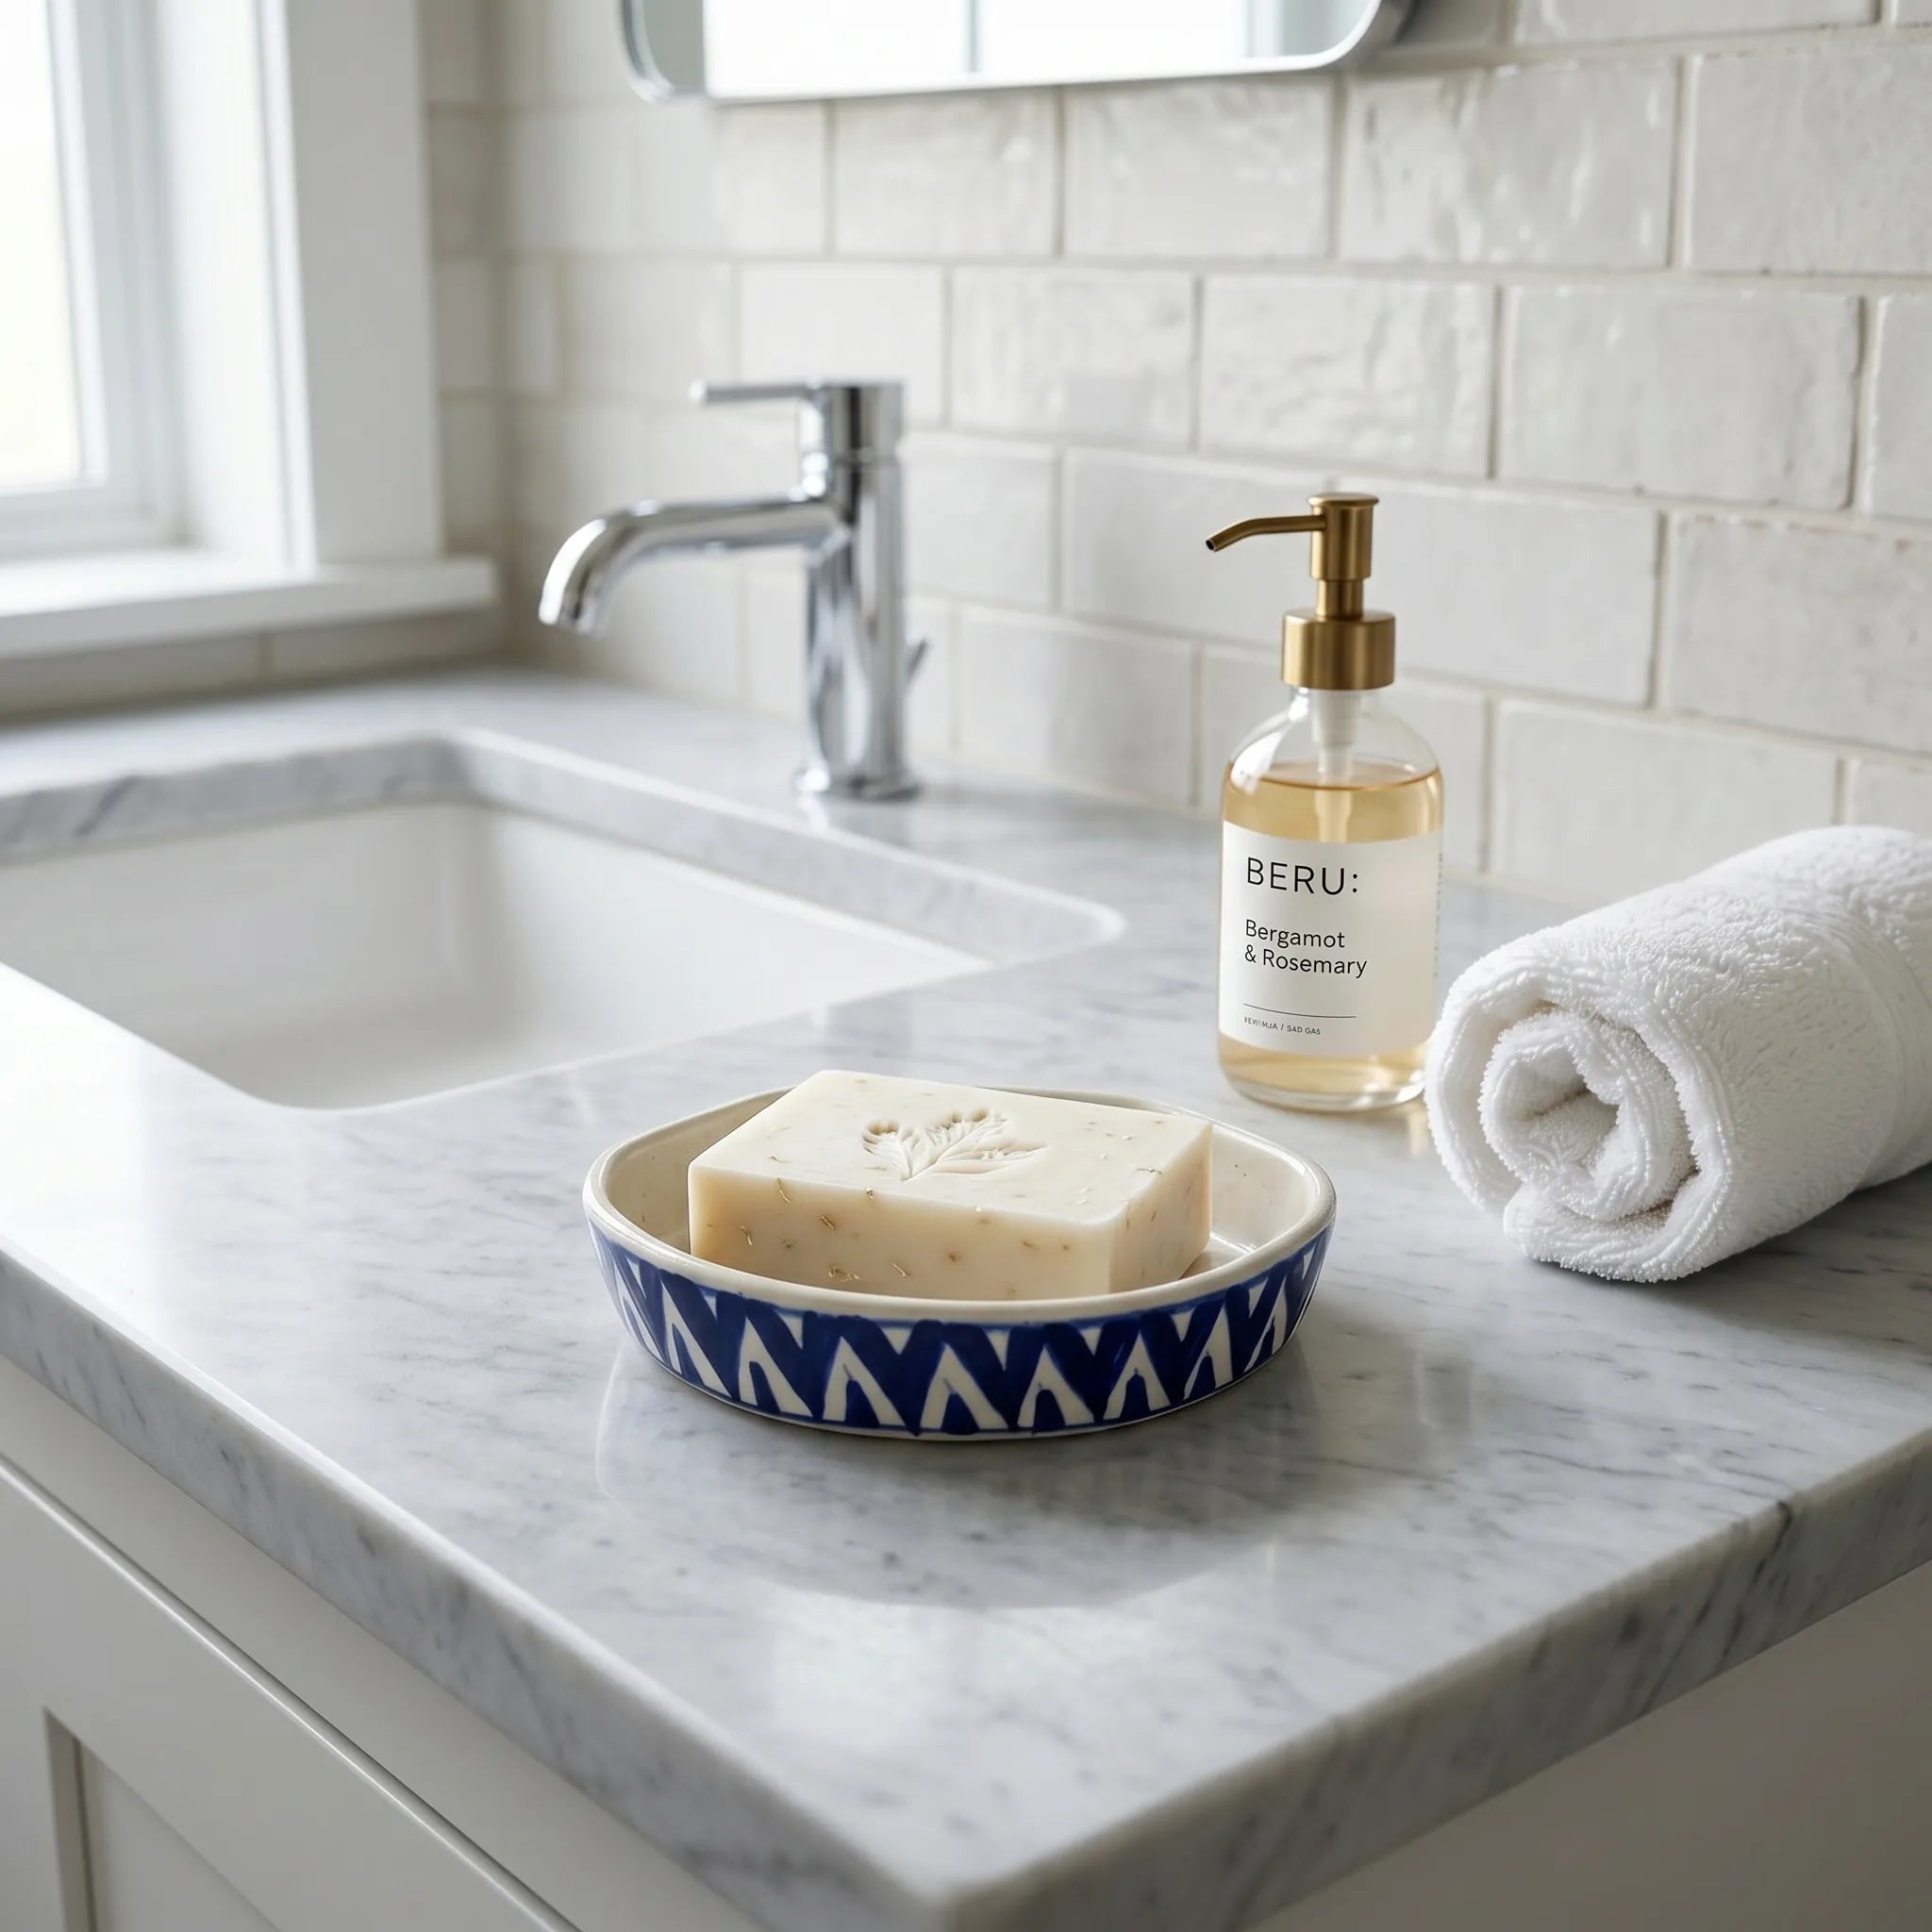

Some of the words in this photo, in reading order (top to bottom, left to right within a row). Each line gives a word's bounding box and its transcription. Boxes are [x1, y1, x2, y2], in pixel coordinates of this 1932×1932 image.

[1246, 856, 1358, 896] BERU:
[1245, 919, 1345, 949] Bergamot
[1244, 944, 1257, 963] &
[1263, 948, 1368, 979] Rosemary
